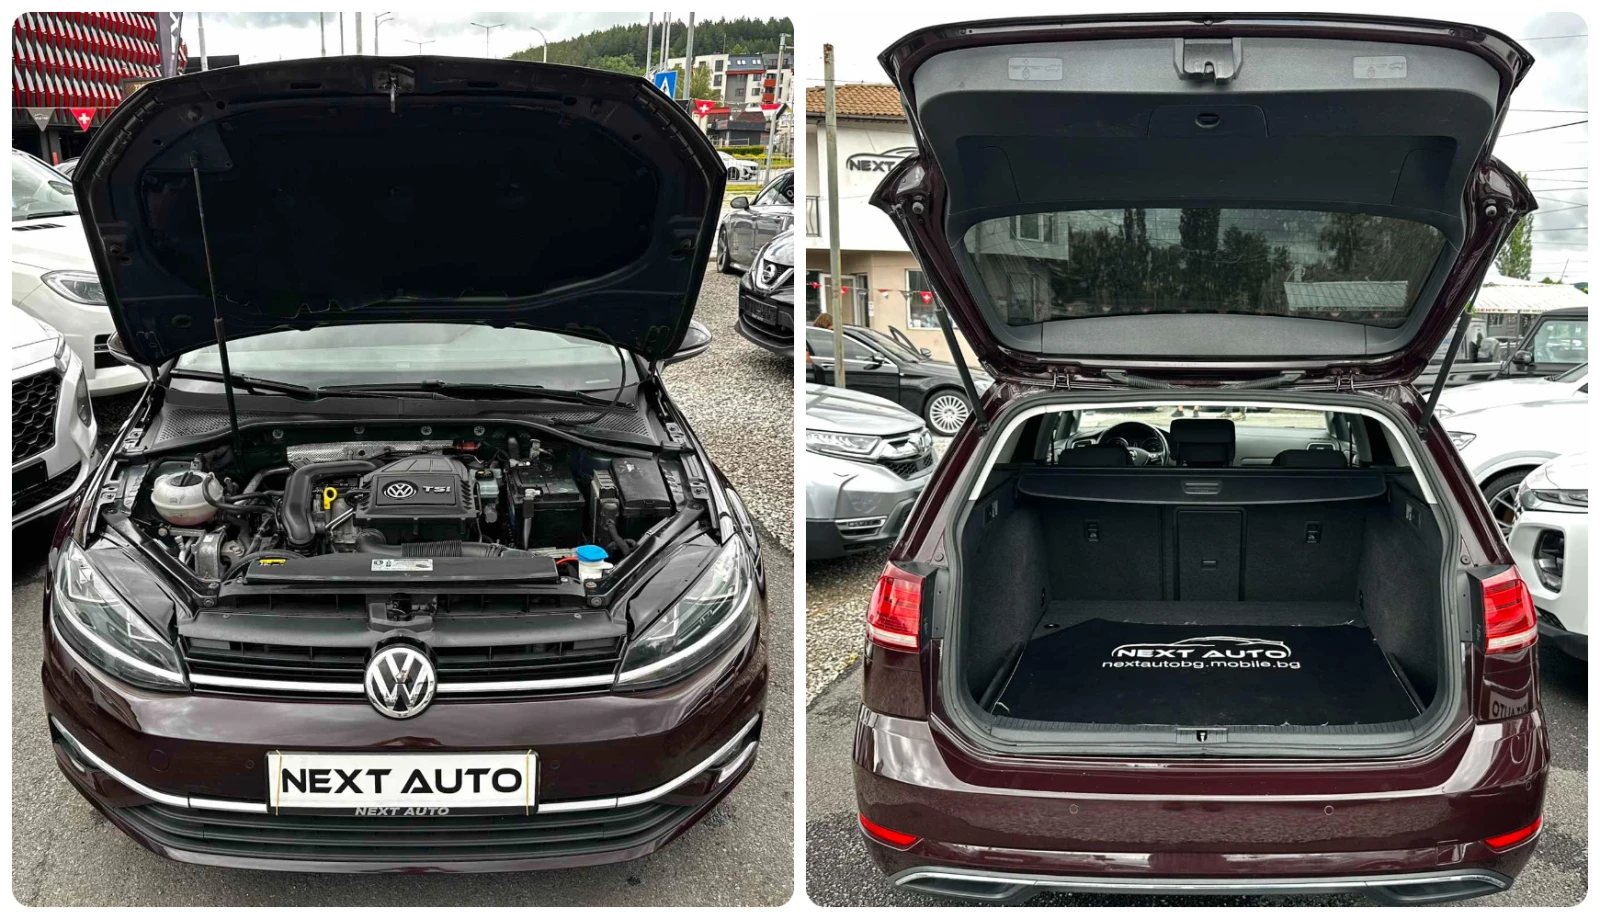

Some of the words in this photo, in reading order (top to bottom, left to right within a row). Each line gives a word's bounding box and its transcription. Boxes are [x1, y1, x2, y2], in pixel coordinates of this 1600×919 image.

[849, 159, 896, 173] NEXT
[422, 485, 451, 493] TSI
[1117, 649, 1195, 658] NEXT
[1201, 649, 1287, 659] AUTO
[1101, 660, 1301, 669] nextautobg.mobile.bg
[282, 768, 392, 794] NEXT
[400, 767, 522, 794] AUTO
[355, 807, 400, 816] NEXT
[404, 807, 450, 816] AUTO
